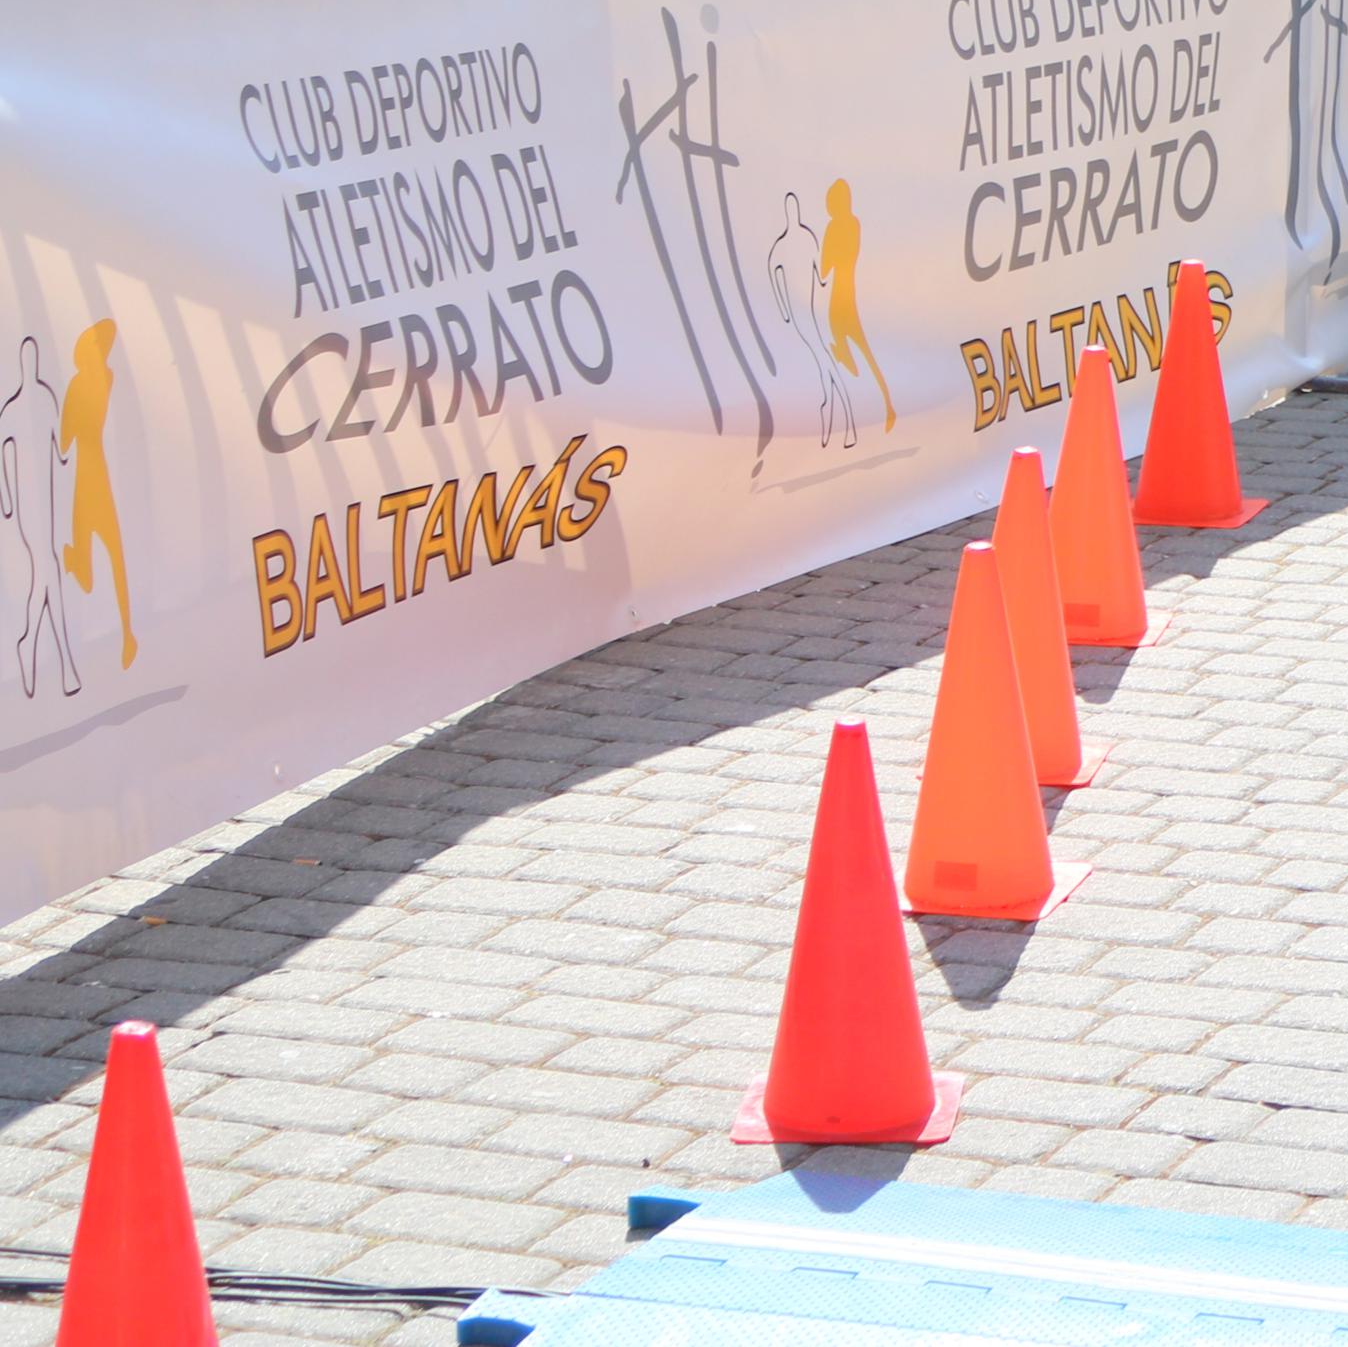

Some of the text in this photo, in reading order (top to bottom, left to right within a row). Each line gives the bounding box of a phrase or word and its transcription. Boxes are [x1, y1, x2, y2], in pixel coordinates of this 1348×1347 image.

[240, 42, 542, 174] CLUB DEPORTIVO
[958, 31, 1221, 172] ATLETISMO DEL
[282, 145, 578, 319] ATLETISMO DEL
[963, 129, 1219, 283] CERRATO
[256, 268, 614, 454] CERRATO
[959, 260, 1234, 433] BALTANS
[251, 434, 629, 658] BALTANÁS
